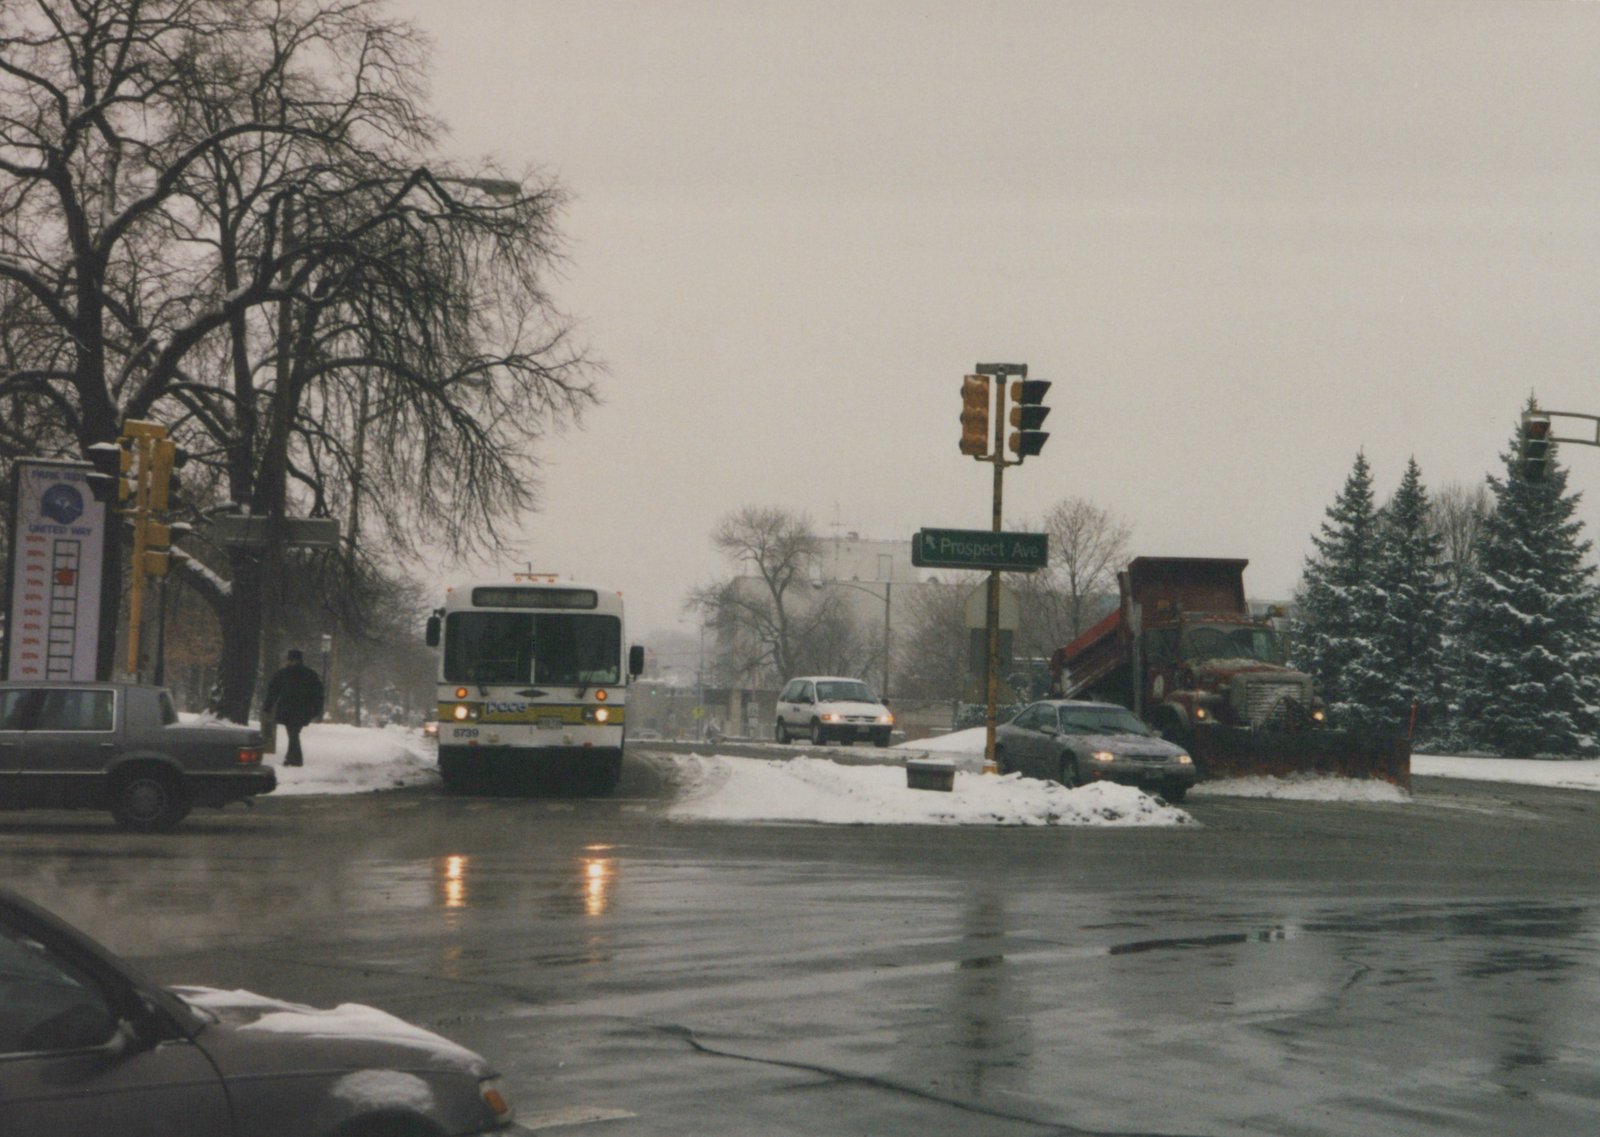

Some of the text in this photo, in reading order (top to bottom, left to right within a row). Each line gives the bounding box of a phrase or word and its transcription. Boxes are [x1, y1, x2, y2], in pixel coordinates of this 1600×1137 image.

[28, 523, 93, 537] UNITED WAY
[939, 537, 1039, 560] Prospect Ave
[486, 701, 528, 714] pace
[453, 728, 479, 738] 8739
